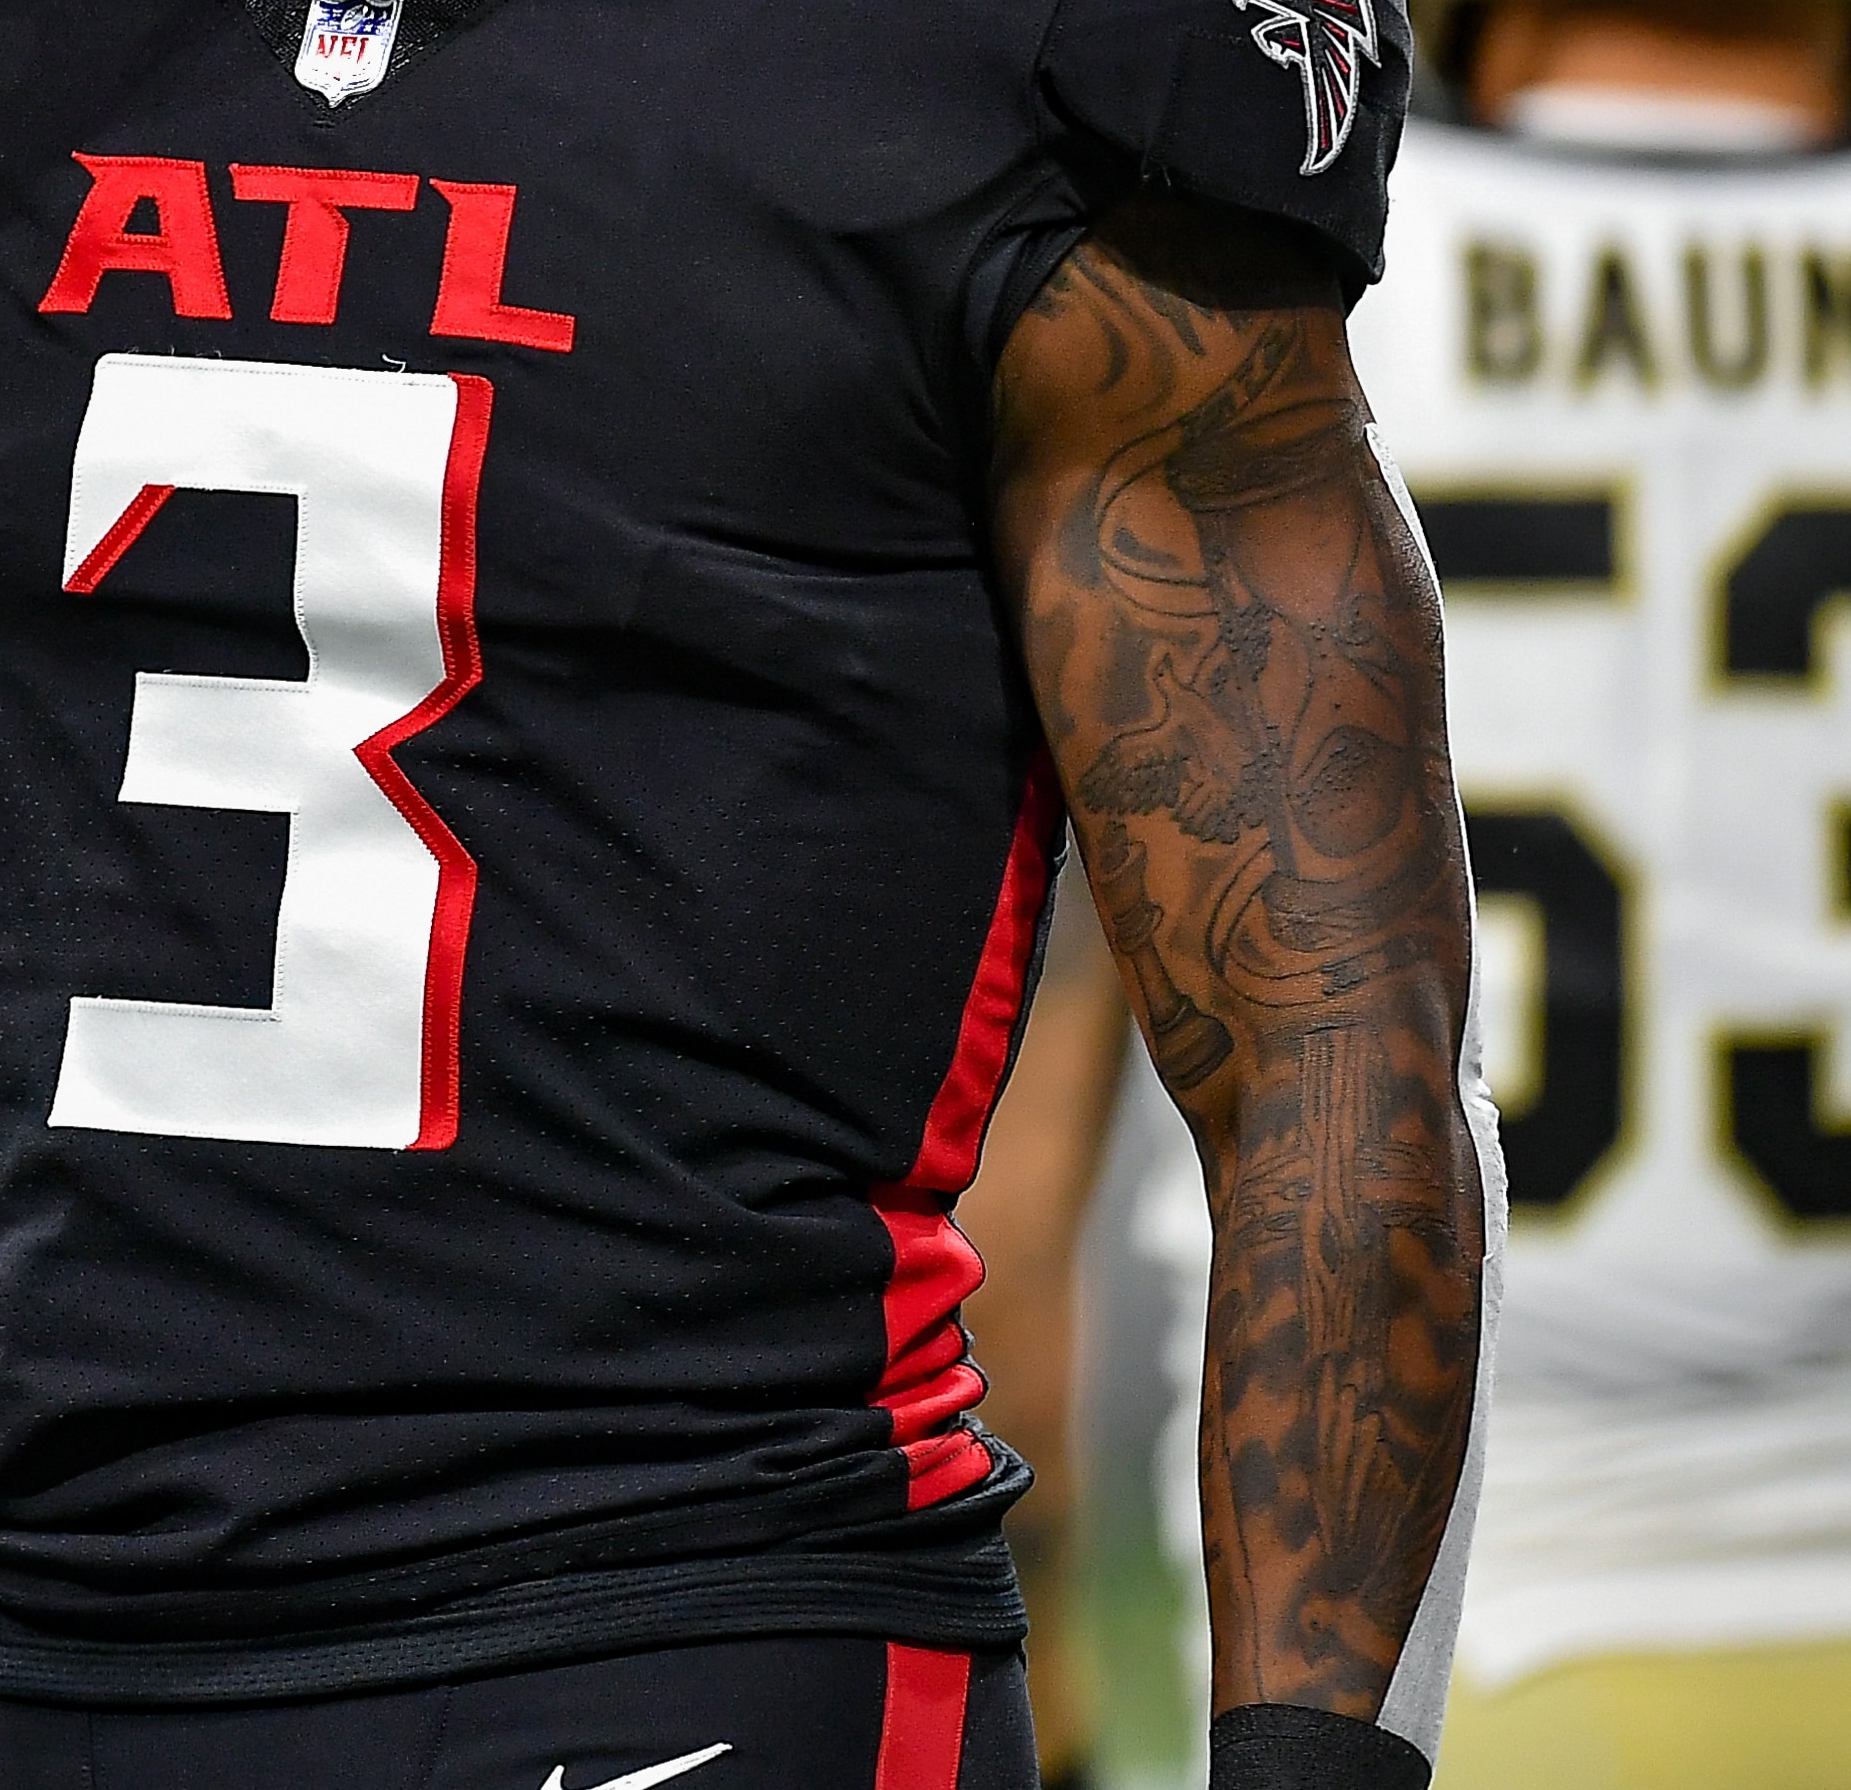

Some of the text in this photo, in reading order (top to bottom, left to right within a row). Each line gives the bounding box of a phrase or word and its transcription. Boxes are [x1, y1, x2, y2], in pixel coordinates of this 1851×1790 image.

[36, 150, 576, 353] ATL
[316, 33, 371, 65] NFL
[47, 352, 494, 1152] 3
[1414, 476, 1851, 1230] 53
